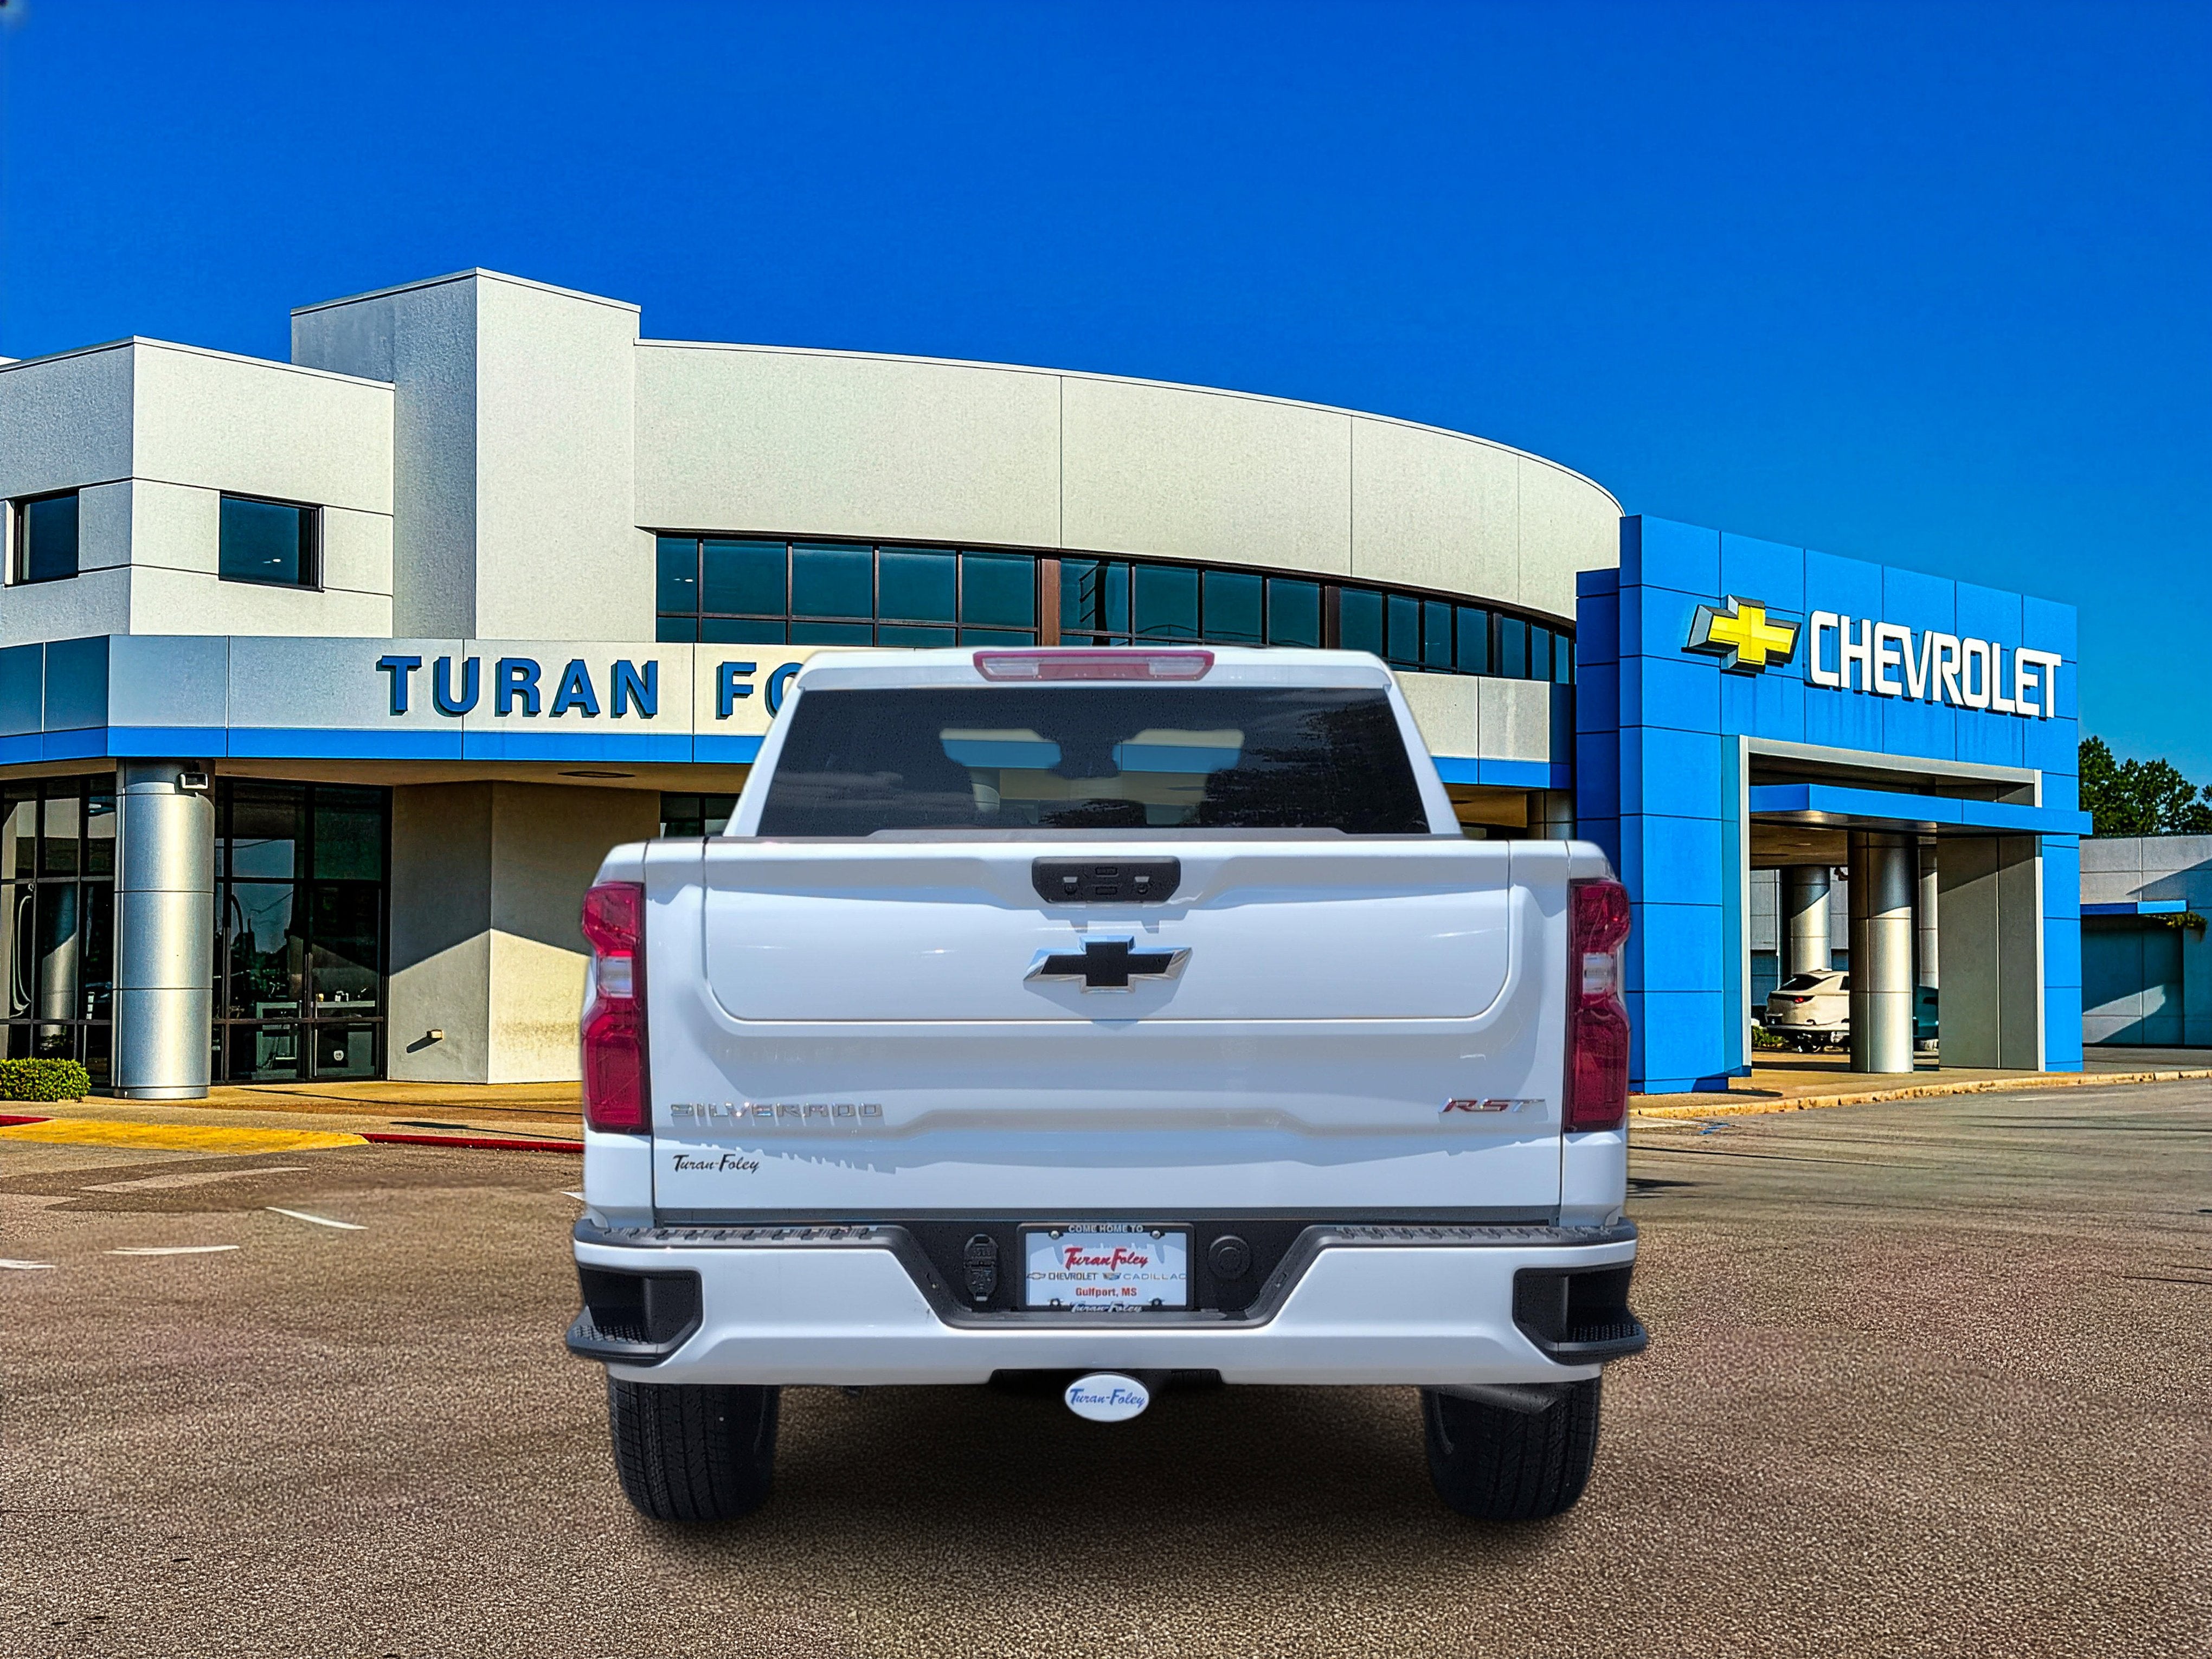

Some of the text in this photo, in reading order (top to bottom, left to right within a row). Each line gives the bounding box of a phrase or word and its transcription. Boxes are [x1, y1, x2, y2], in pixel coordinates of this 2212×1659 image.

[1810, 610, 2062, 718] CHEVROLET
[377, 655, 659, 718] TURAN
[670, 1102, 883, 1117] SILVERADO
[1438, 1097, 1546, 1113] RST
[1068, 1224, 1144, 1233] COME HOME TO
[1048, 1272, 1187, 1281] CHEVROLET CADILLAC
[1075, 1287, 1137, 1298] Gulfport, MS
